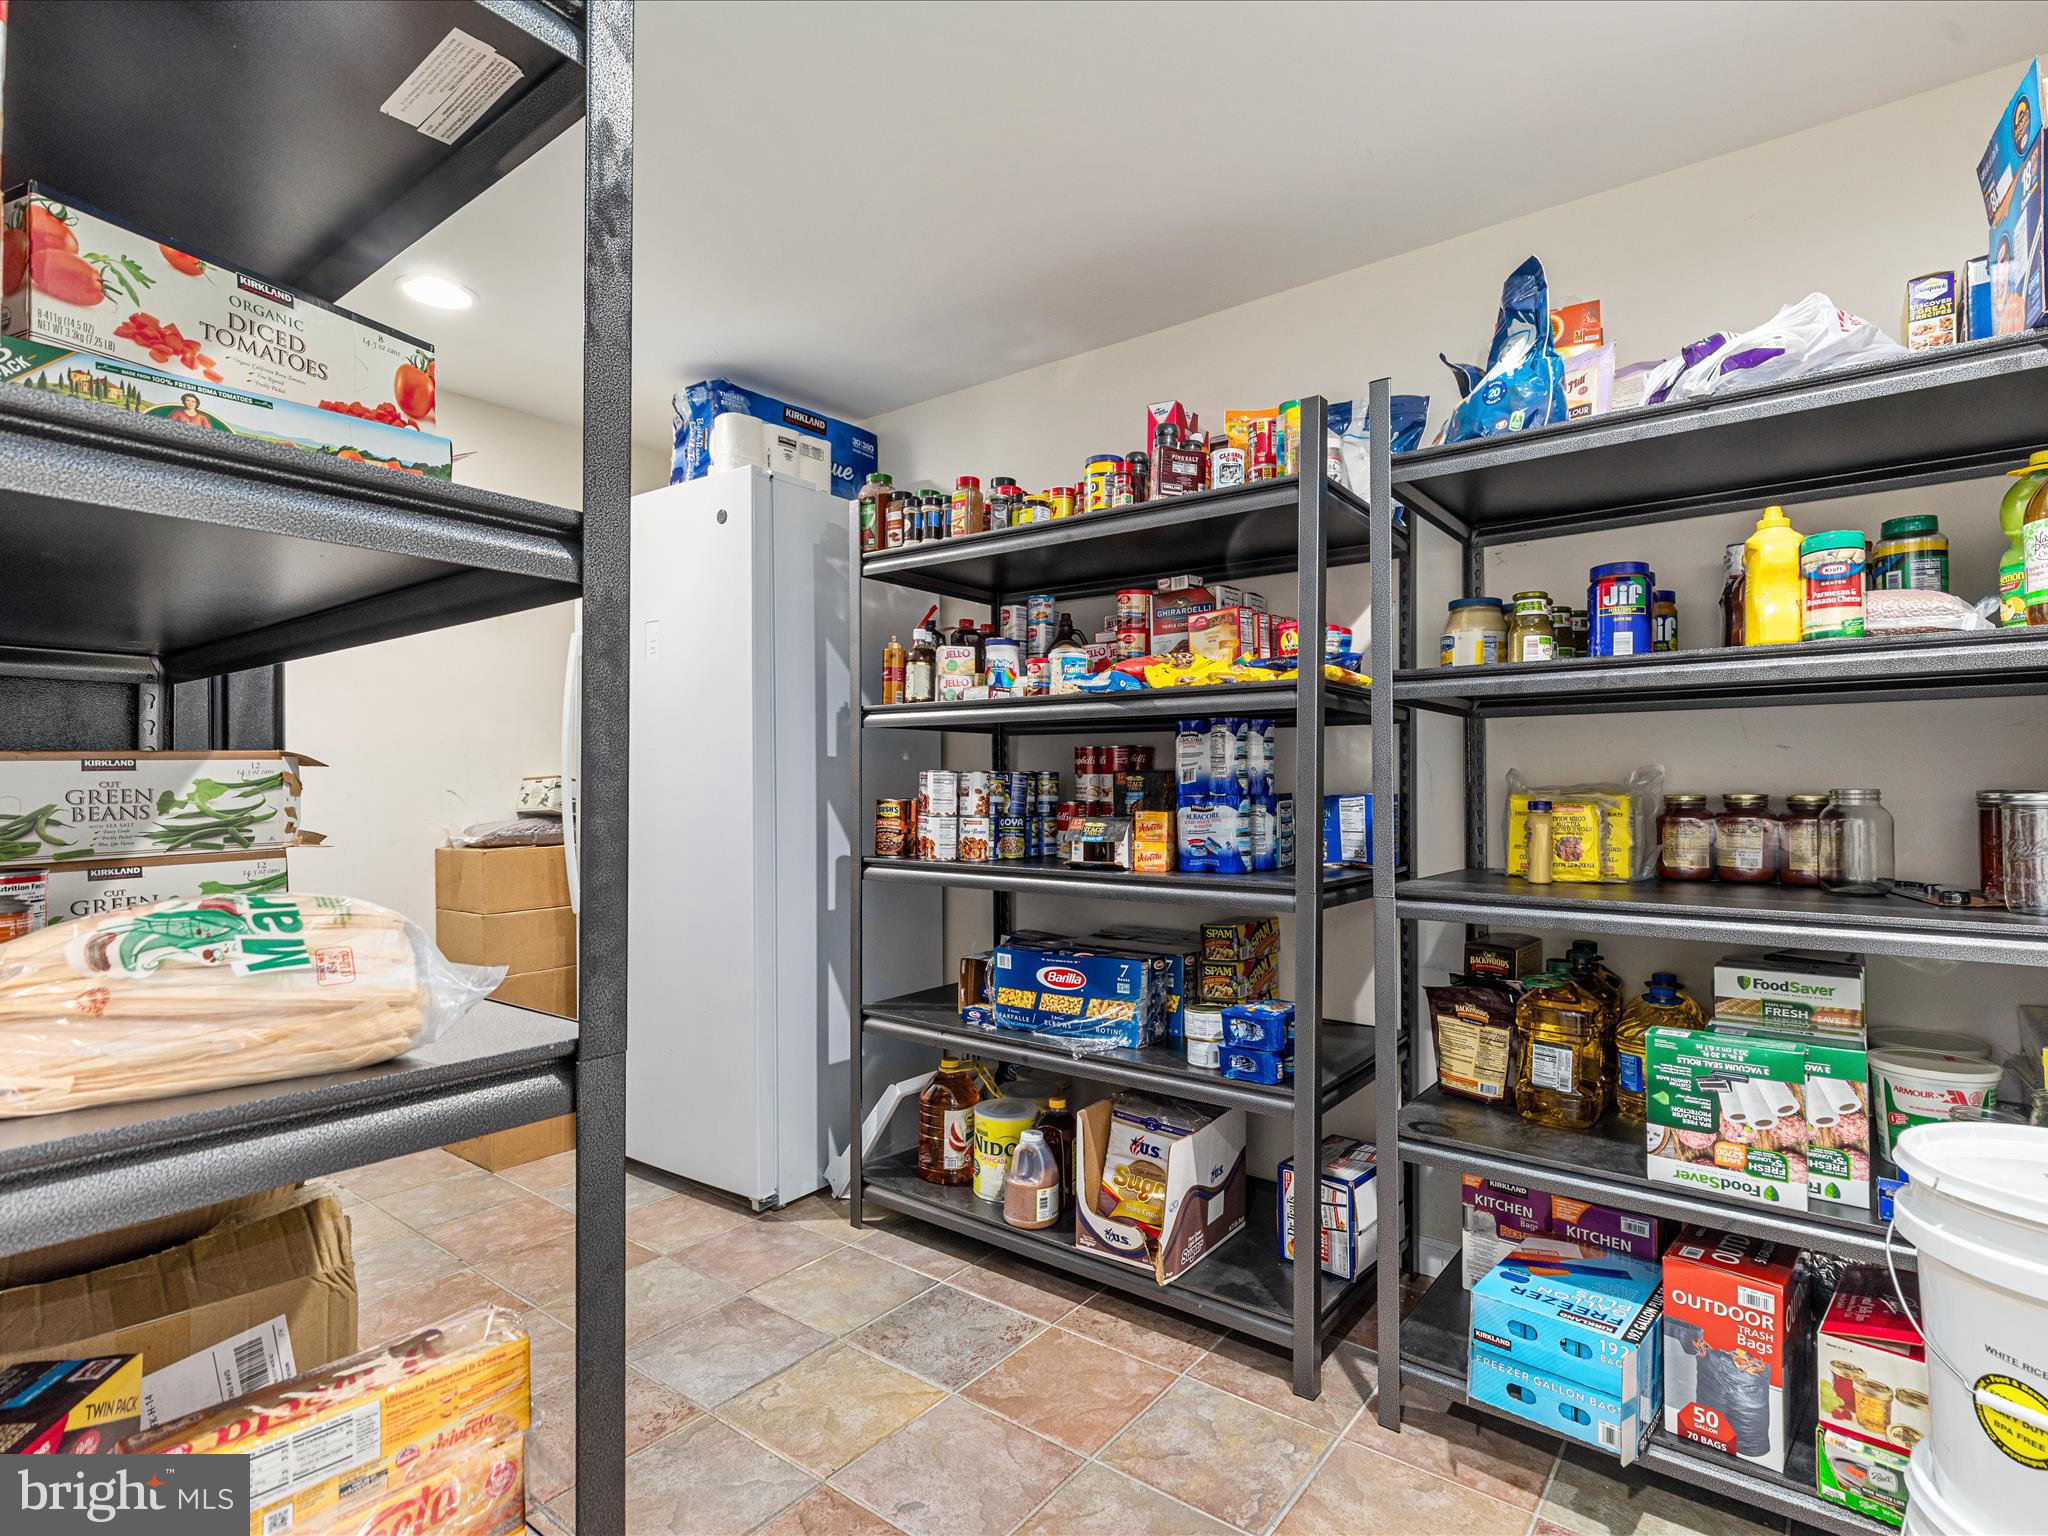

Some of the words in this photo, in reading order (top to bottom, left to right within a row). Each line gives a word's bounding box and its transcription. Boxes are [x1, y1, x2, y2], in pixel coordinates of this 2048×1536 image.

[239, 275, 292, 303] KIRKLAND
[229, 295, 304, 332] ORGANIC
[1918, 302, 1952, 314] GREAT
[38, 322, 50, 332] NET
[51, 324, 63, 336] WT
[228, 312, 306, 354] DICED
[378, 335, 384, 344] 8
[200, 321, 328, 380] TOMATOES
[122, 369, 136, 378] MADE
[136, 372, 150, 380] FROM
[152, 376, 173, 386] 100%
[175, 381, 196, 392] FRESH
[198, 385, 216, 396] ROMA
[218, 390, 252, 404] TOMATOES
[1568, 374, 1586, 394] Mill
[1488, 388, 1500, 398] 20
[785, 408, 826, 430] KIRKLAND
[1824, 566, 1843, 574] Kraft
[1604, 584, 1642, 606] Jif
[1812, 590, 1850, 600] Parmesan
[1156, 604, 1212, 618] GHIRARDELLI
[944, 649, 970, 660] JELL-O
[944, 678, 970, 688] JELL-O
[84, 759, 134, 768] KIRKLAND
[250, 762, 260, 770] 12
[98, 781, 120, 789] CUT
[65, 788, 154, 806] GREEN
[72, 805, 151, 823] BEANS
[878, 806, 899, 814] BUSH'S
[1000, 818, 1024, 827] GOYA
[91, 867, 140, 878] KIRKLAND
[104, 890, 126, 898] CUT
[1206, 929, 1232, 938] SPAM
[1251, 922, 1270, 947] SPAM
[1470, 955, 1510, 969] BACKWOODS
[1047, 971, 1082, 985] Barilla
[1120, 964, 1130, 978] 7
[1204, 966, 1232, 976] SPAM
[1250, 958, 1269, 986] SPAM
[1753, 978, 1836, 997] FoodSaver
[1000, 1012, 1030, 1022] FARFALLE
[1455, 1004, 1490, 1019] BACKWOODS
[1764, 1007, 1809, 1020] FRESH
[1044, 1020, 1072, 1028] ELBOWS
[1816, 1014, 1842, 1024] SAVE
[1096, 1027, 1122, 1036] ROTINI
[1676, 1056, 1702, 1068] ROLLS
[1702, 1060, 1722, 1070] SEAL
[1724, 1063, 1763, 1076] VACUUM
[1764, 1068, 1770, 1076] 3
[1893, 1085, 1934, 1099] ARMOUR
[1671, 1106, 1712, 1118] PROTECTION
[1672, 1111, 1712, 1123] MULTI-LAYER
[1682, 1119, 1699, 1127] FREE
[1139, 1144, 1162, 1160] U.S.
[1748, 1162, 1786, 1176] FRESH
[1808, 1160, 1848, 1172] FRESH
[1489, 1180, 1527, 1195] KIRKLAND
[1673, 1170, 1760, 1197] FoodSaver
[1126, 1204, 1140, 1213] Pure
[1475, 1194, 1533, 1218] KITCHEN
[1520, 1219, 1538, 1231] Bags
[1112, 1233, 1131, 1246] U.S.
[1566, 1225, 1632, 1252] KITCHEN
[1510, 1286, 1624, 1326] FREEZER
[1536, 1286, 1628, 1317] GALLON
[1574, 1290, 1633, 1310] PLUS
[1672, 1289, 1775, 1332] OUTDOOR
[1560, 1312, 1614, 1333] KIRKLAND
[1634, 1306, 1658, 1330] GALLON
[1476, 1330, 1511, 1347] KIRKLAND
[1738, 1324, 1774, 1342] TRASH
[1737, 1333, 1773, 1355] Bags
[1600, 1354, 1622, 1368] BAG
[1985, 1344, 2019, 1368] WHITE
[2022, 1363, 2048, 1381] RICE
[385, 1384, 424, 1404] Ultimate
[426, 1364, 467, 1388] Macaroni
[478, 1352, 507, 1368] Cheese
[1476, 1355, 1530, 1382] FREEZER
[1533, 1376, 1585, 1402] GALLON
[86, 1401, 115, 1420] TWIN
[116, 1396, 139, 1414] PACK
[1692, 1405, 1719, 1428] 50
[1694, 1422, 1718, 1435] GALLON
[1687, 1430, 1699, 1442] 70
[1700, 1435, 1728, 1452] BAGS
[1994, 1419, 2014, 1436] BPA
[2016, 1432, 2046, 1453] FREE
